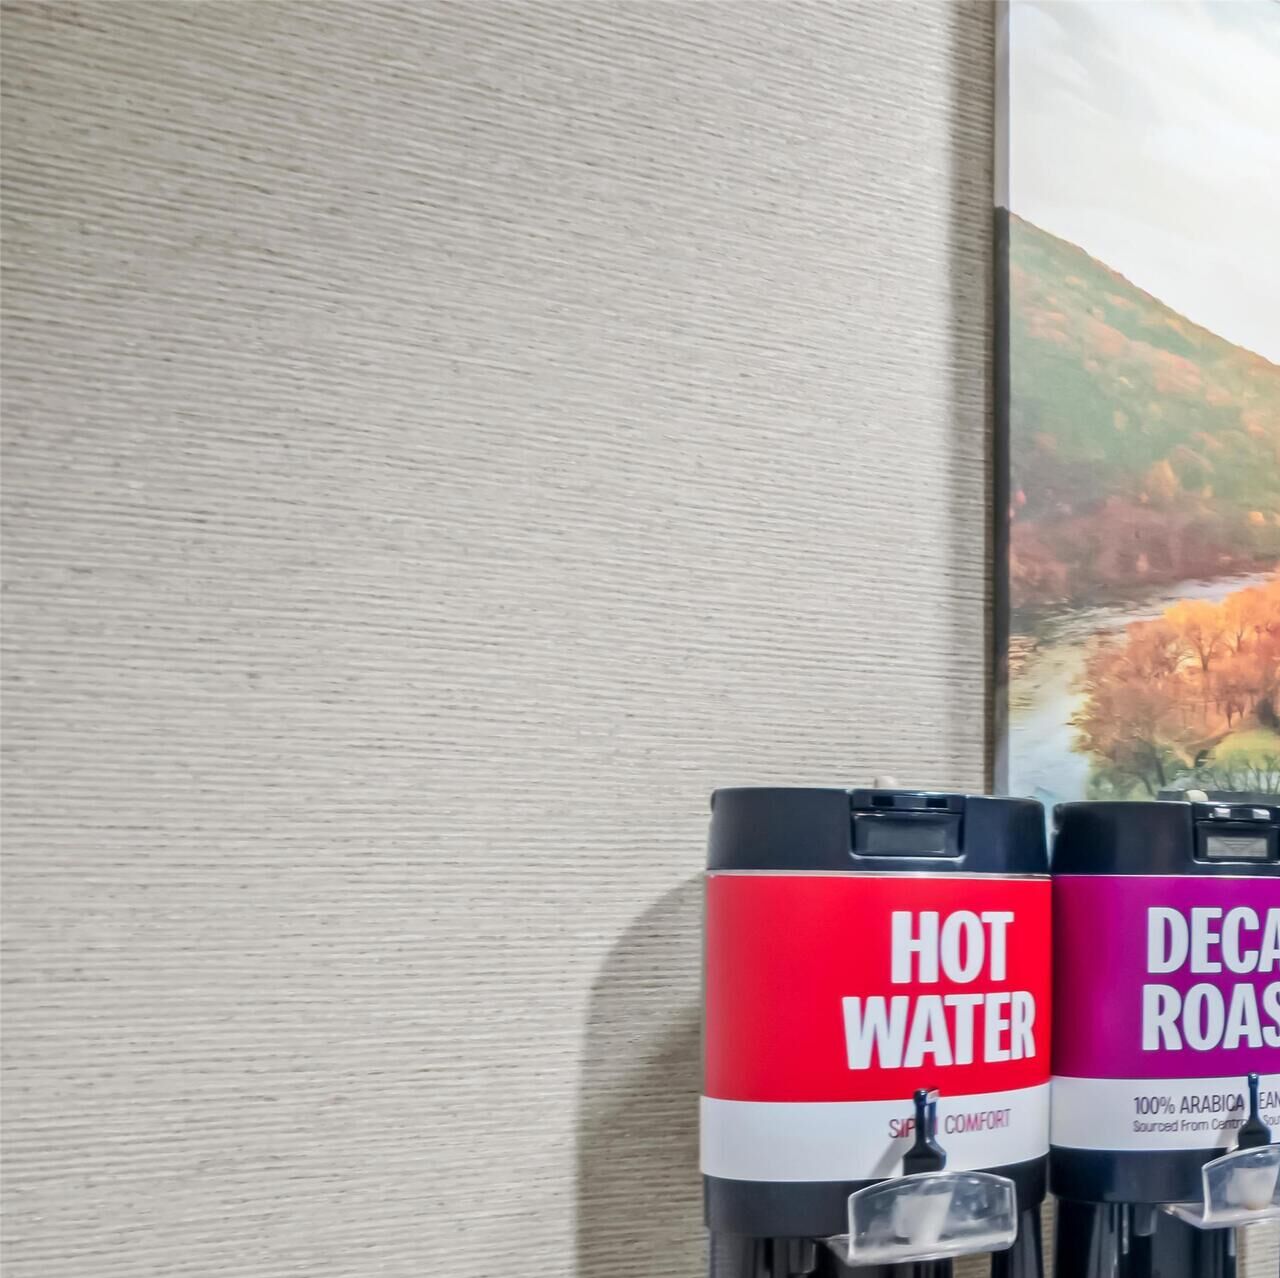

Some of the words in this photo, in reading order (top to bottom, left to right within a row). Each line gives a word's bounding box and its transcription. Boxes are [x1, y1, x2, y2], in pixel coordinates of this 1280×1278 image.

[891, 910, 1014, 983] HOT
[842, 991, 1036, 1069] WATER
[1133, 1096, 1175, 1115] 100%
[1179, 1093, 1245, 1114] ARABICA
[888, 1118, 915, 1139] SIP
[944, 1108, 1011, 1134] COMFORT
[1133, 1119, 1179, 1133] Sourced
[1181, 1118, 1209, 1131] From
